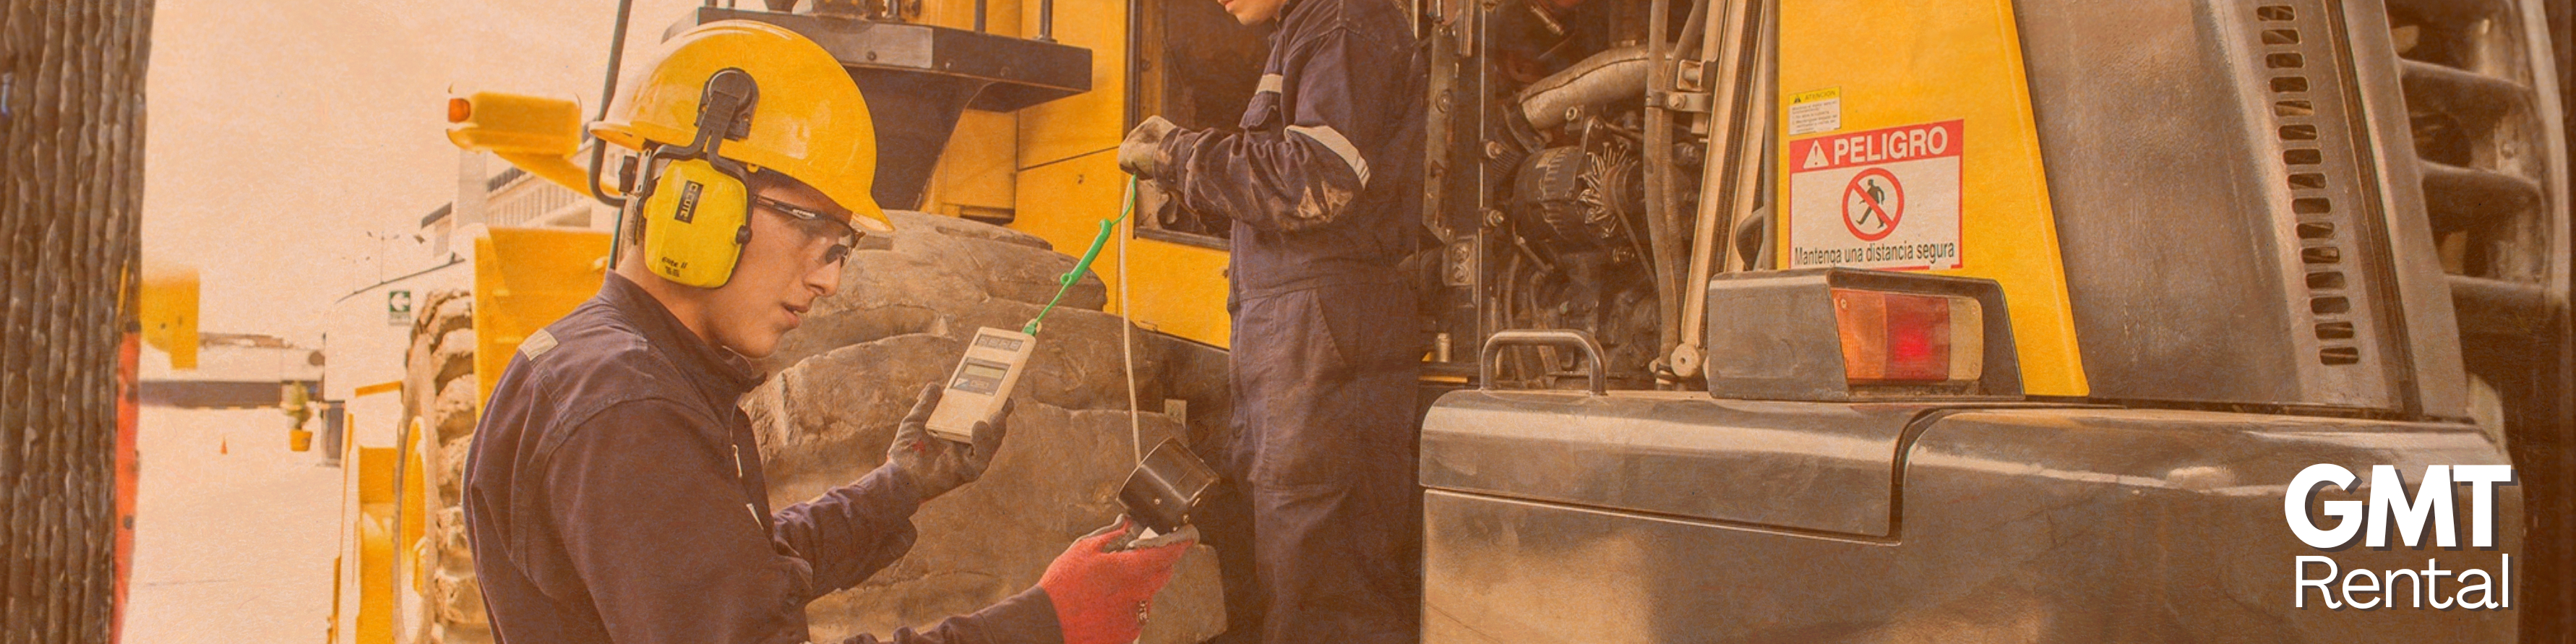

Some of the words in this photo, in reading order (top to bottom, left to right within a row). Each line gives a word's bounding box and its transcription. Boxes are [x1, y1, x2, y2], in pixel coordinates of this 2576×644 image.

[1834, 126, 1948, 165] PELIGRO
[1795, 246, 1841, 267] Mantenga
[1845, 247, 1863, 262] una
[1866, 241, 1913, 262] distancia
[1916, 242, 1954, 264] segura
